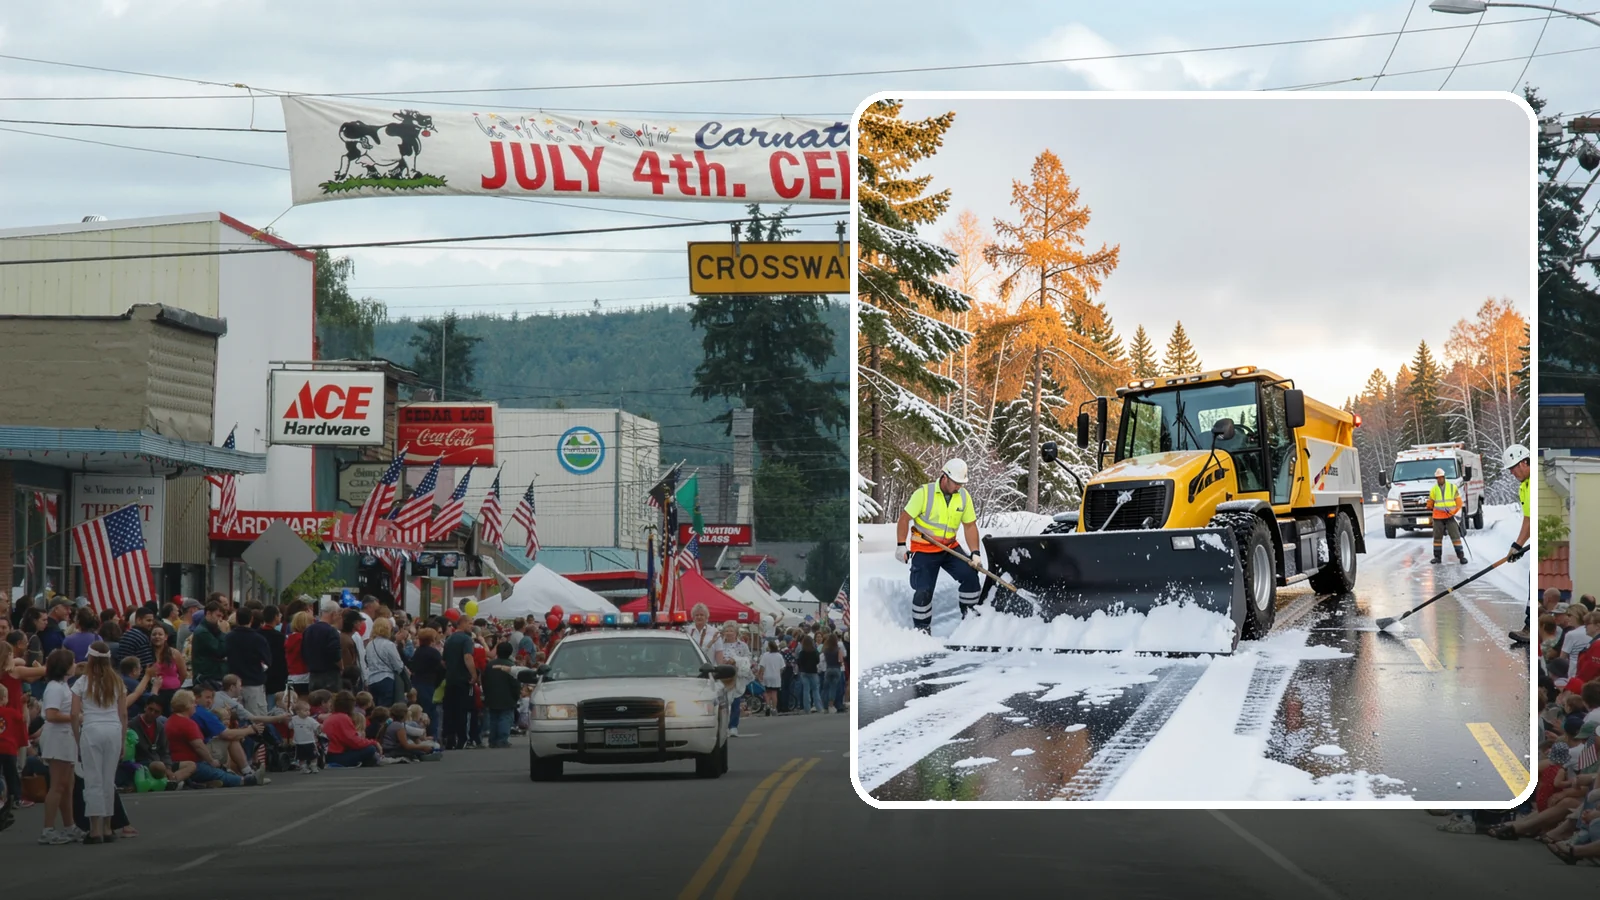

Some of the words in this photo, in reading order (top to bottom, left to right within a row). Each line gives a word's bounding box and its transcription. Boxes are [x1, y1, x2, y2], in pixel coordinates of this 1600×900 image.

[694, 121, 850, 150] Carnat
[481, 141, 604, 192] JULY
[632, 150, 746, 198] 4th.
[697, 254, 850, 280] CROSSWA
[282, 380, 373, 420] ACE
[405, 409, 453, 422] CEDAR
[460, 409, 486, 422] LOG
[283, 420, 371, 437] Hardware
[353, 467, 385, 481] Simpl
[95, 485, 124, 495] Vincent
[126, 486, 136, 495] de
[137, 485, 155, 495] Paul
[688, 526, 741, 535] CRNATION
[699, 535, 730, 543] GLASS
